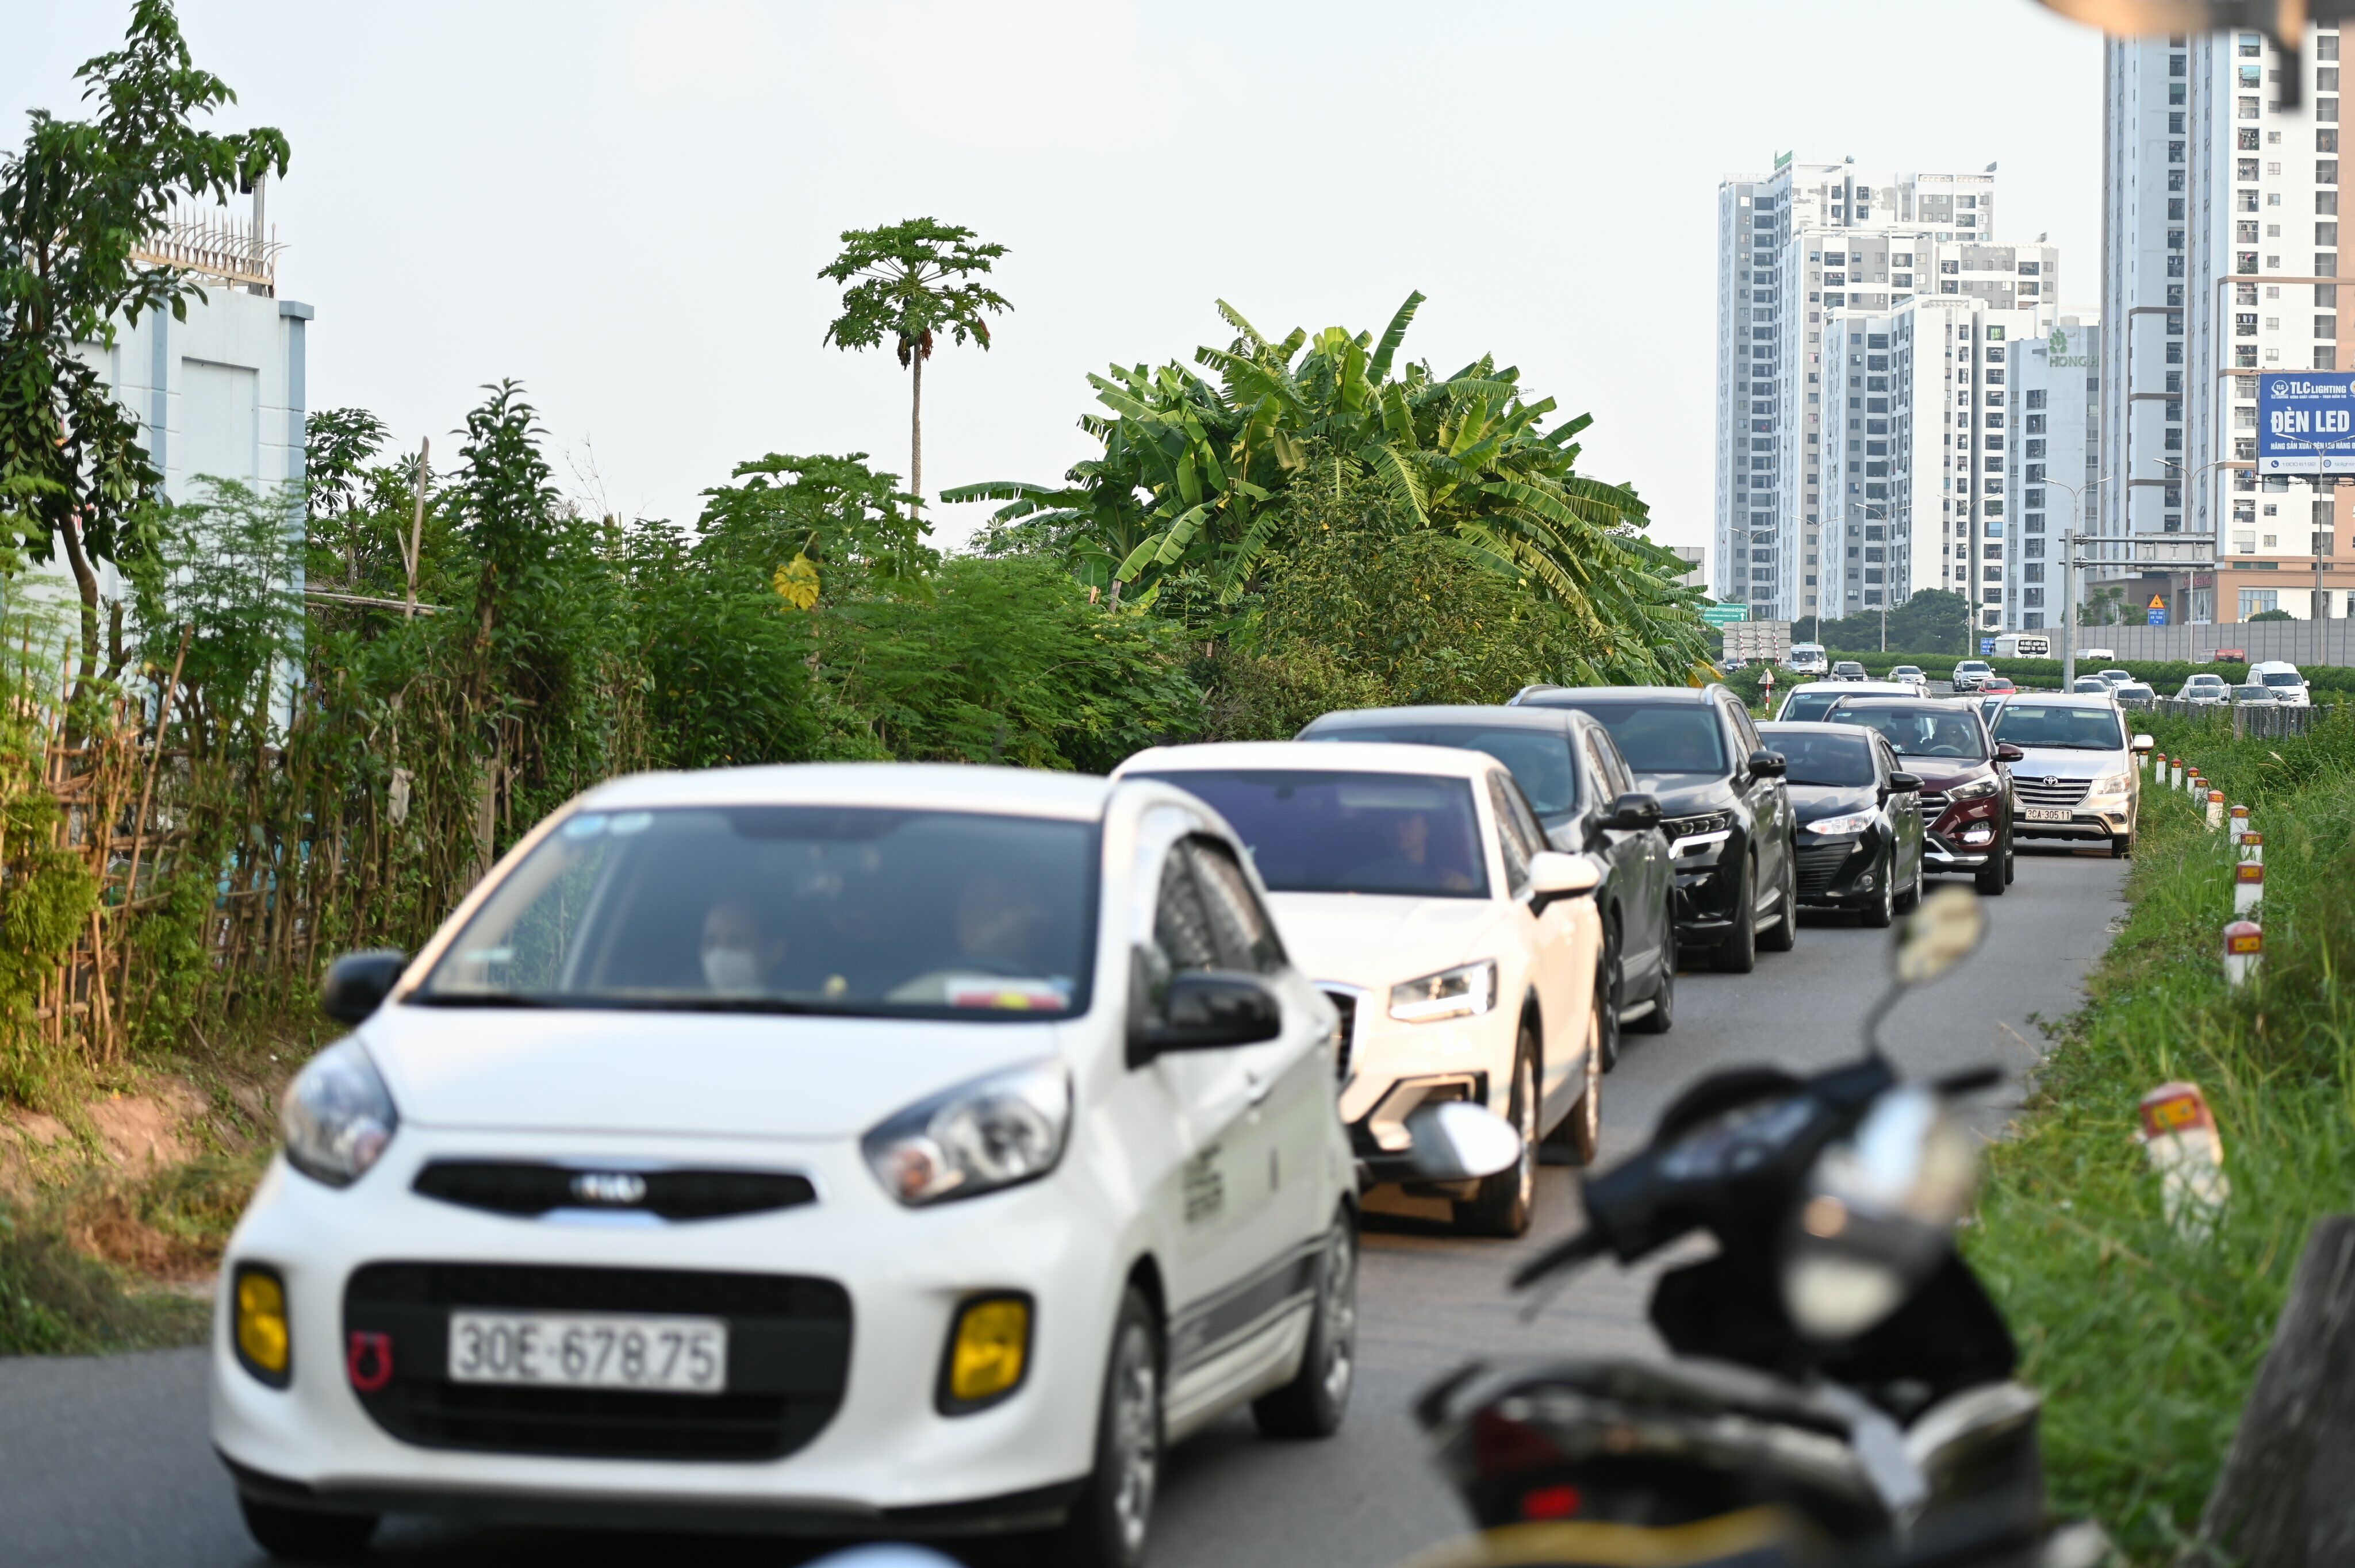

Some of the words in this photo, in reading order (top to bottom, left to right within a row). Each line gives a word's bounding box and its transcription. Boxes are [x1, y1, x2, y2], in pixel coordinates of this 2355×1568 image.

[2049, 355, 2087, 367] HONG
[2290, 382, 2311, 394] TLC
[2311, 385, 2346, 394] LIGHTING
[2270, 406, 2309, 433] ĐÈN
[2315, 410, 2350, 432] LED
[2336, 441, 2351, 449] HÀNG
[458, 1321, 716, 1385] 30E-678.75
